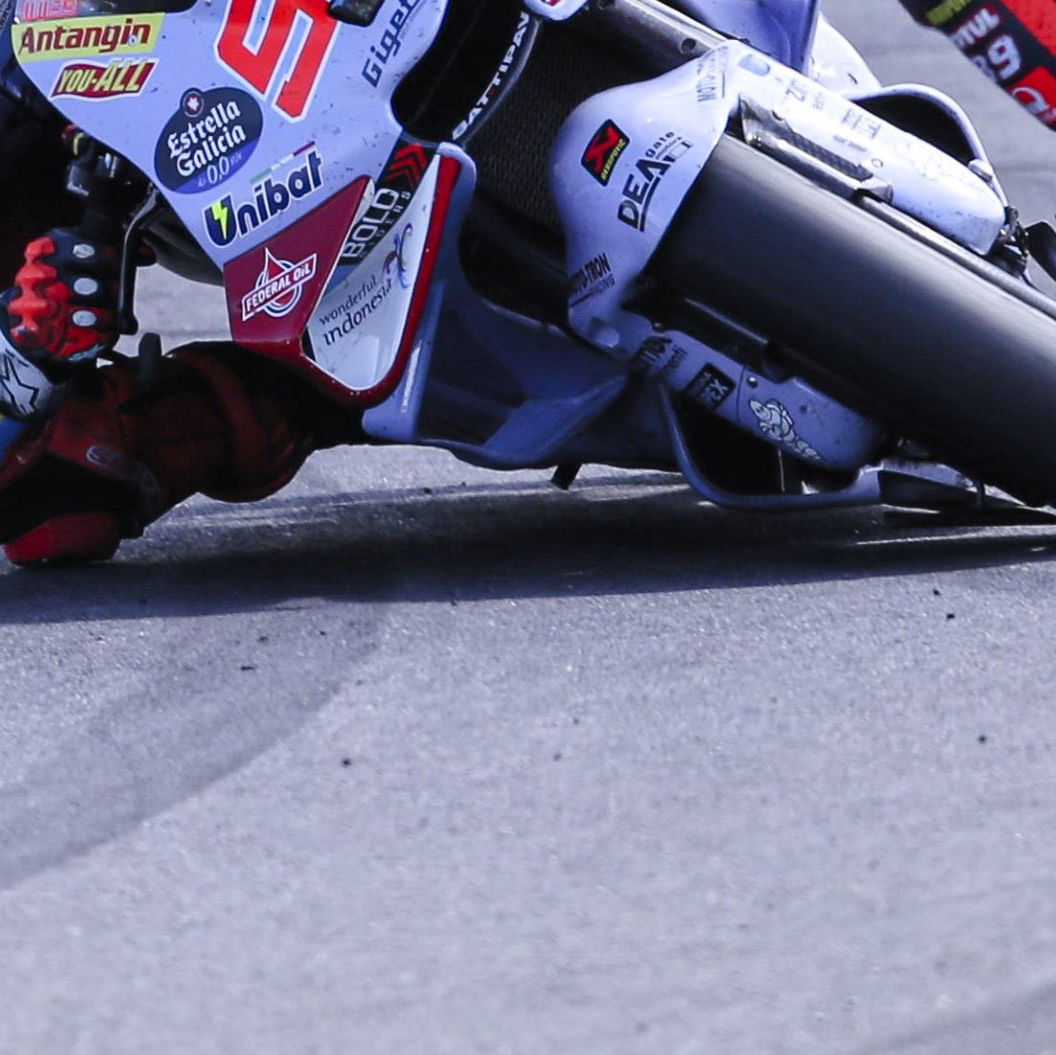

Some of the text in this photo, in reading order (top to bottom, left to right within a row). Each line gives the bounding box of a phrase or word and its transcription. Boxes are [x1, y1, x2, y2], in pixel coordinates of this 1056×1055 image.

[18, 18, 151, 54] Antangin
[952, 8, 999, 49] TUL
[167, 101, 240, 158] Estrella
[177, 125, 247, 177] Galicia
[203, 150, 323, 247] Unibat
[343, 188, 399, 258] BOLD
[246, 264, 312, 313] FEDERAL OIL
[319, 276, 377, 326] wonderful
[323, 278, 393, 346] indonesia
